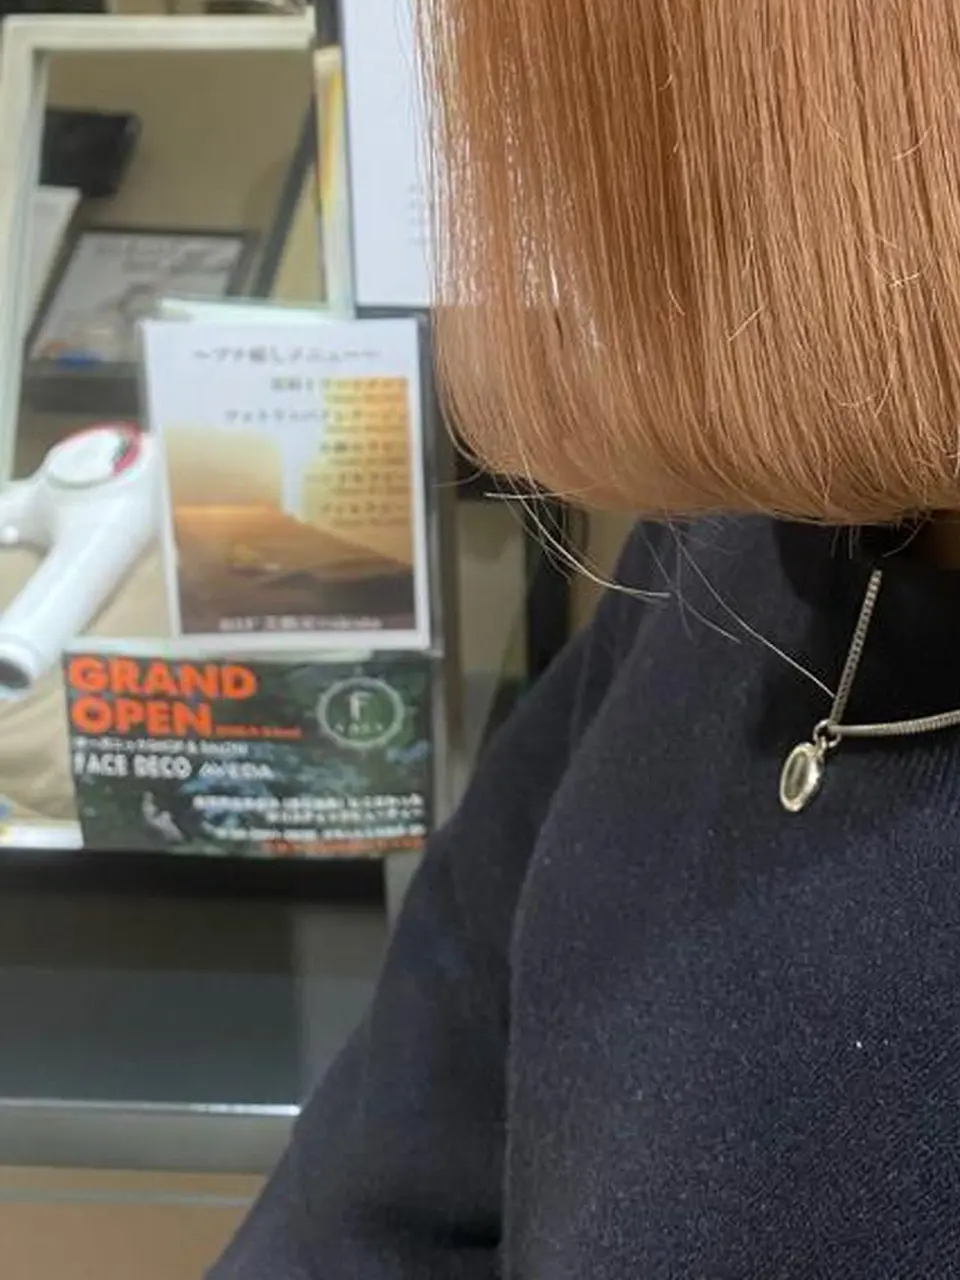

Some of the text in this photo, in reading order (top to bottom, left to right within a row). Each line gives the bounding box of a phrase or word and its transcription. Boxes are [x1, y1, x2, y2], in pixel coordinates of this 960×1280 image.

[68, 656, 257, 700] GRAND
[71, 696, 213, 738] OPEN
[74, 752, 128, 777] FACE
